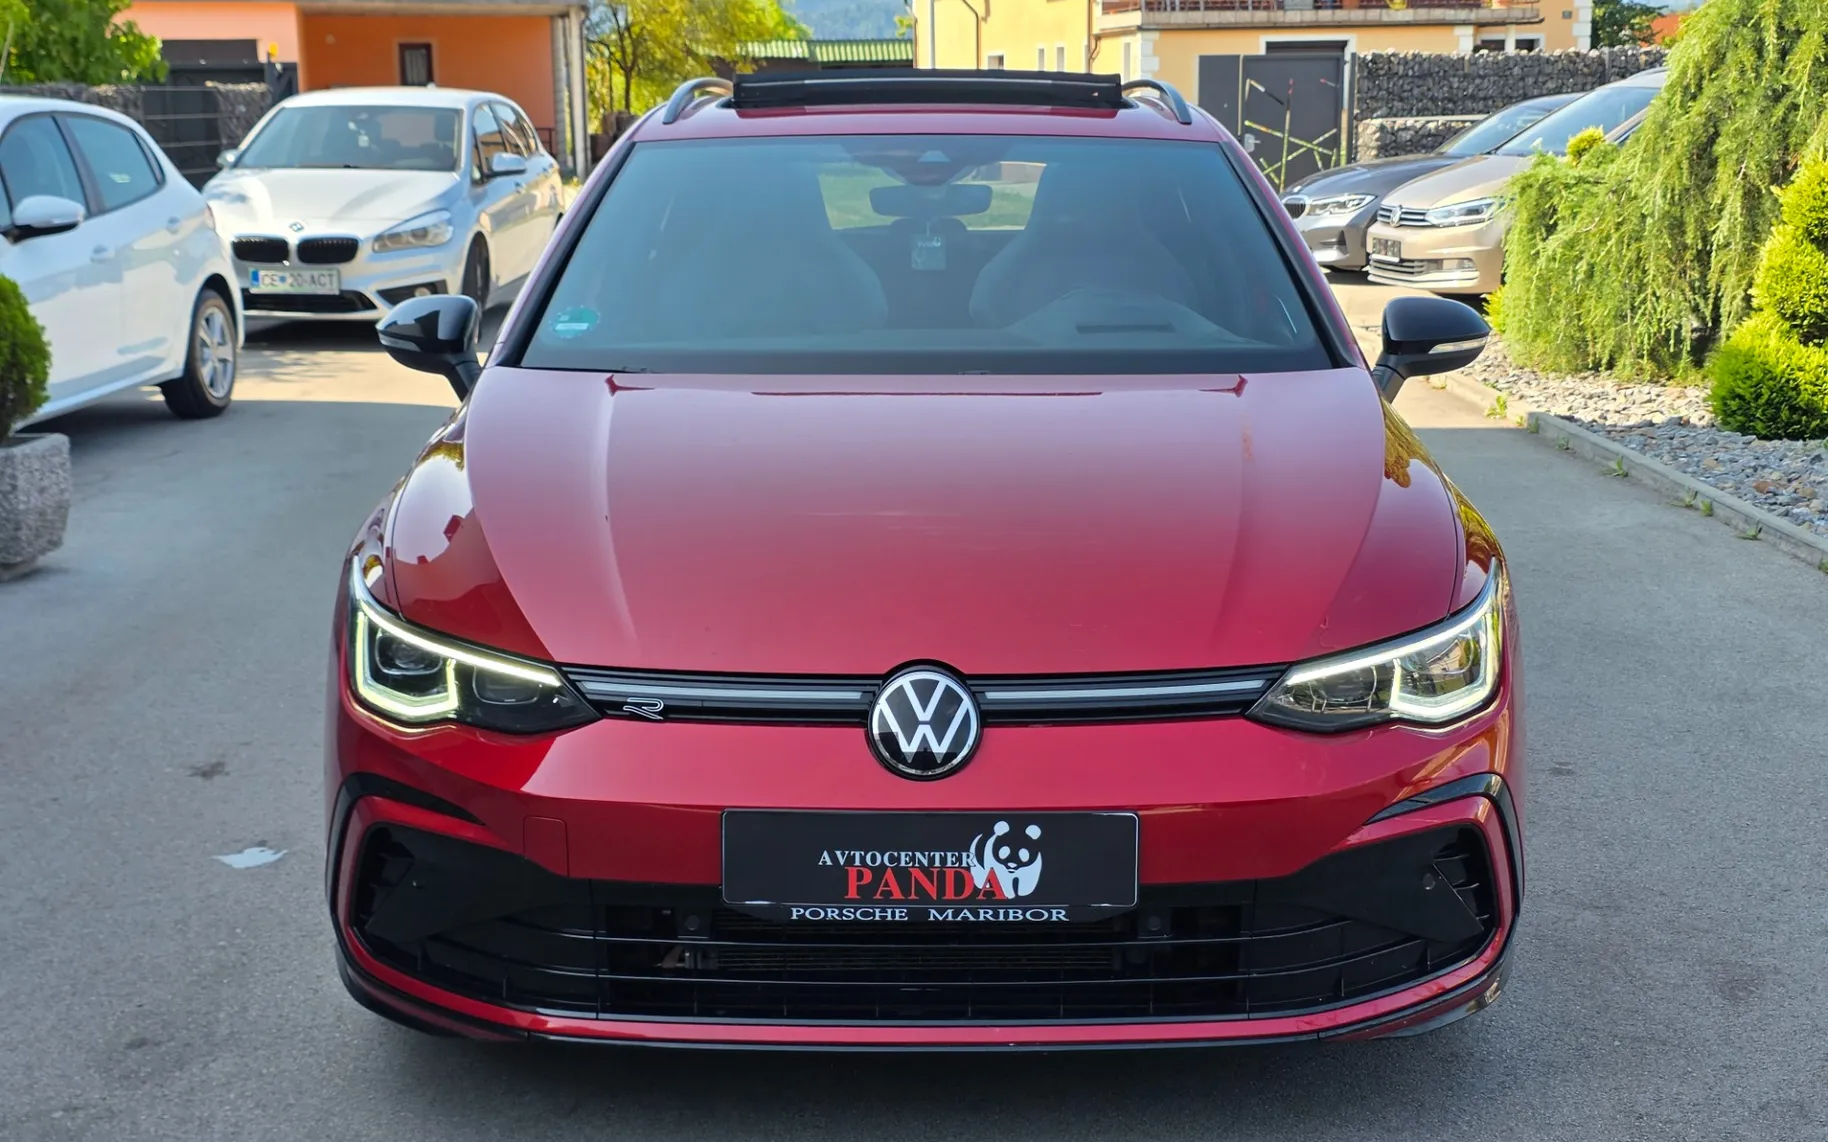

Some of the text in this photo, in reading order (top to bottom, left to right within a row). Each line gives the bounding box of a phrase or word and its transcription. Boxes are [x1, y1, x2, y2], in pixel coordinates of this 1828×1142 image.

[817, 849, 977, 868] AVTOCENTER
[844, 866, 1009, 901] PANDA
[790, 907, 1070, 923] PORSCHE MARIBOR
